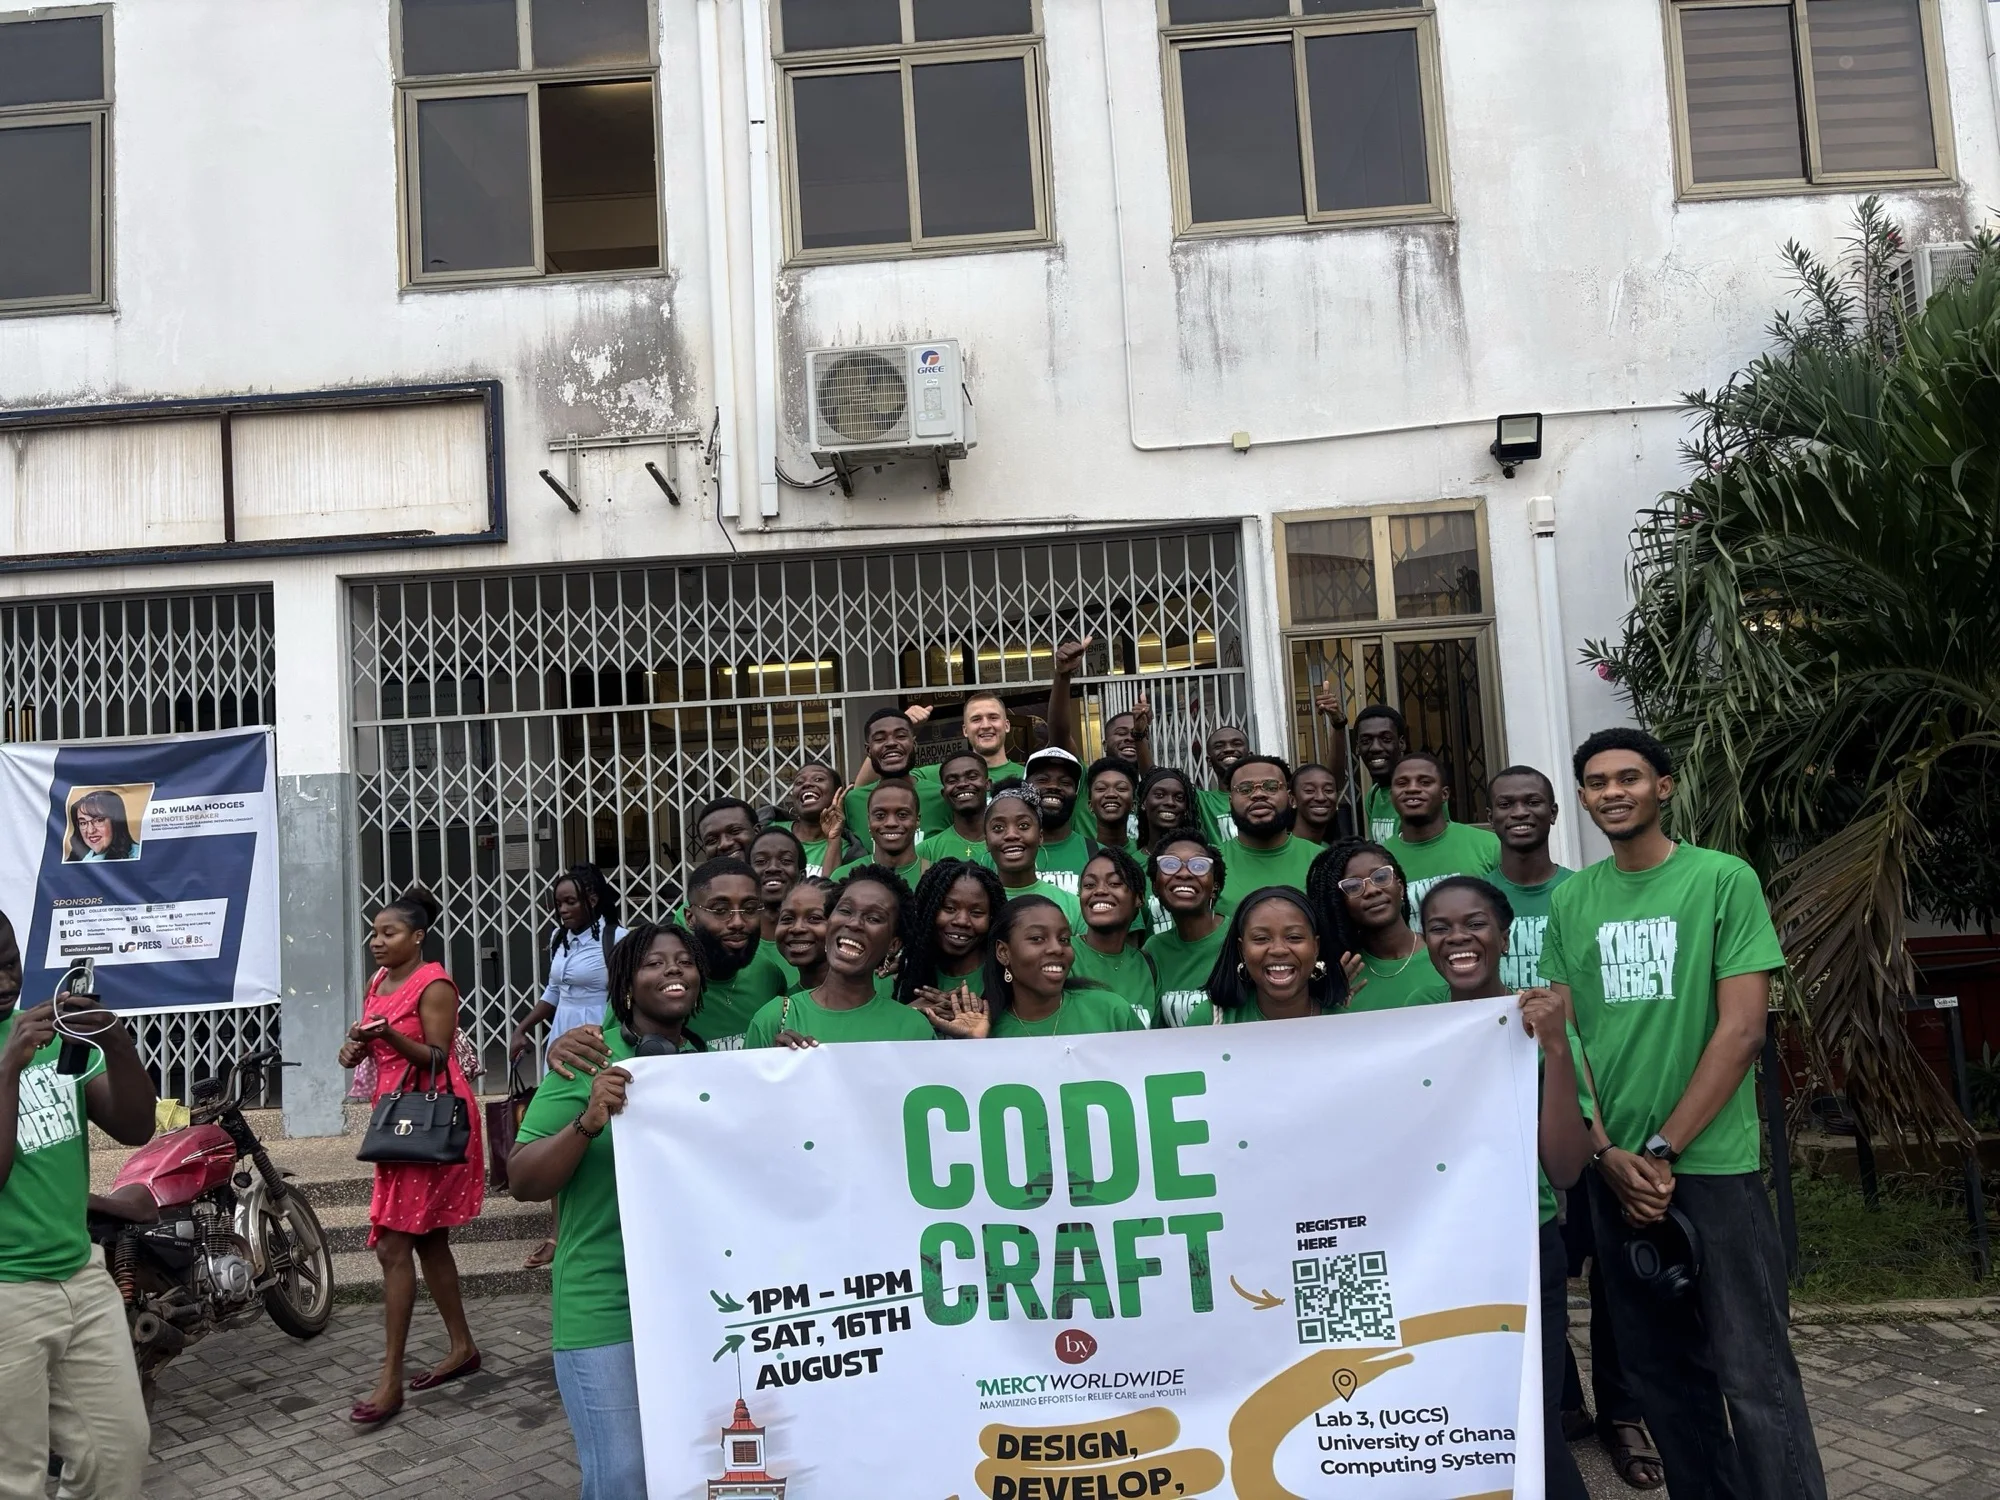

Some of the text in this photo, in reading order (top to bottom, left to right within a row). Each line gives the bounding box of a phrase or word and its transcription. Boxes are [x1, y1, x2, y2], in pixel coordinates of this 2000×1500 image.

[917, 366, 945, 374] GREE
[151, 815, 184, 823] KEYNOTE
[185, 813, 219, 821] SPEAKER
[170, 805, 202, 814] WILMA
[204, 801, 244, 810] HODGES
[53, 897, 103, 906] SPONSORS
[139, 925, 151, 933] UG
[1508, 920, 1548, 956] KNO
[137, 940, 162, 950] PRESS
[171, 936, 204, 946] UG BS
[1598, 922, 1677, 965] KNOW
[1601, 960, 1675, 999] MERCY
[903, 1071, 1217, 1211] CODE
[1295, 1215, 1367, 1234] REGISTER
[1297, 1236, 1338, 1251] HERE
[920, 1212, 1225, 1326] CRAFT
[746, 1284, 810, 1315] 1PM
[844, 1268, 913, 1300] 4PM
[751, 1306, 912, 1353] SAT, 16TH
[1064, 1335, 1092, 1358] by
[756, 1348, 884, 1390] AUGUST
[980, 1388, 1186, 1410] MAXIMIZING EFFORTS for RELIEF CARE and YOUTH
[1315, 1406, 1449, 1430] Lab 3, (UGCS)
[996, 1430, 1138, 1462] DESIGN,
[1318, 1428, 1516, 1451] University of Ghana
[1320, 1450, 1516, 1477] Computing System
[992, 1467, 1185, 1500] DEVELOP,
